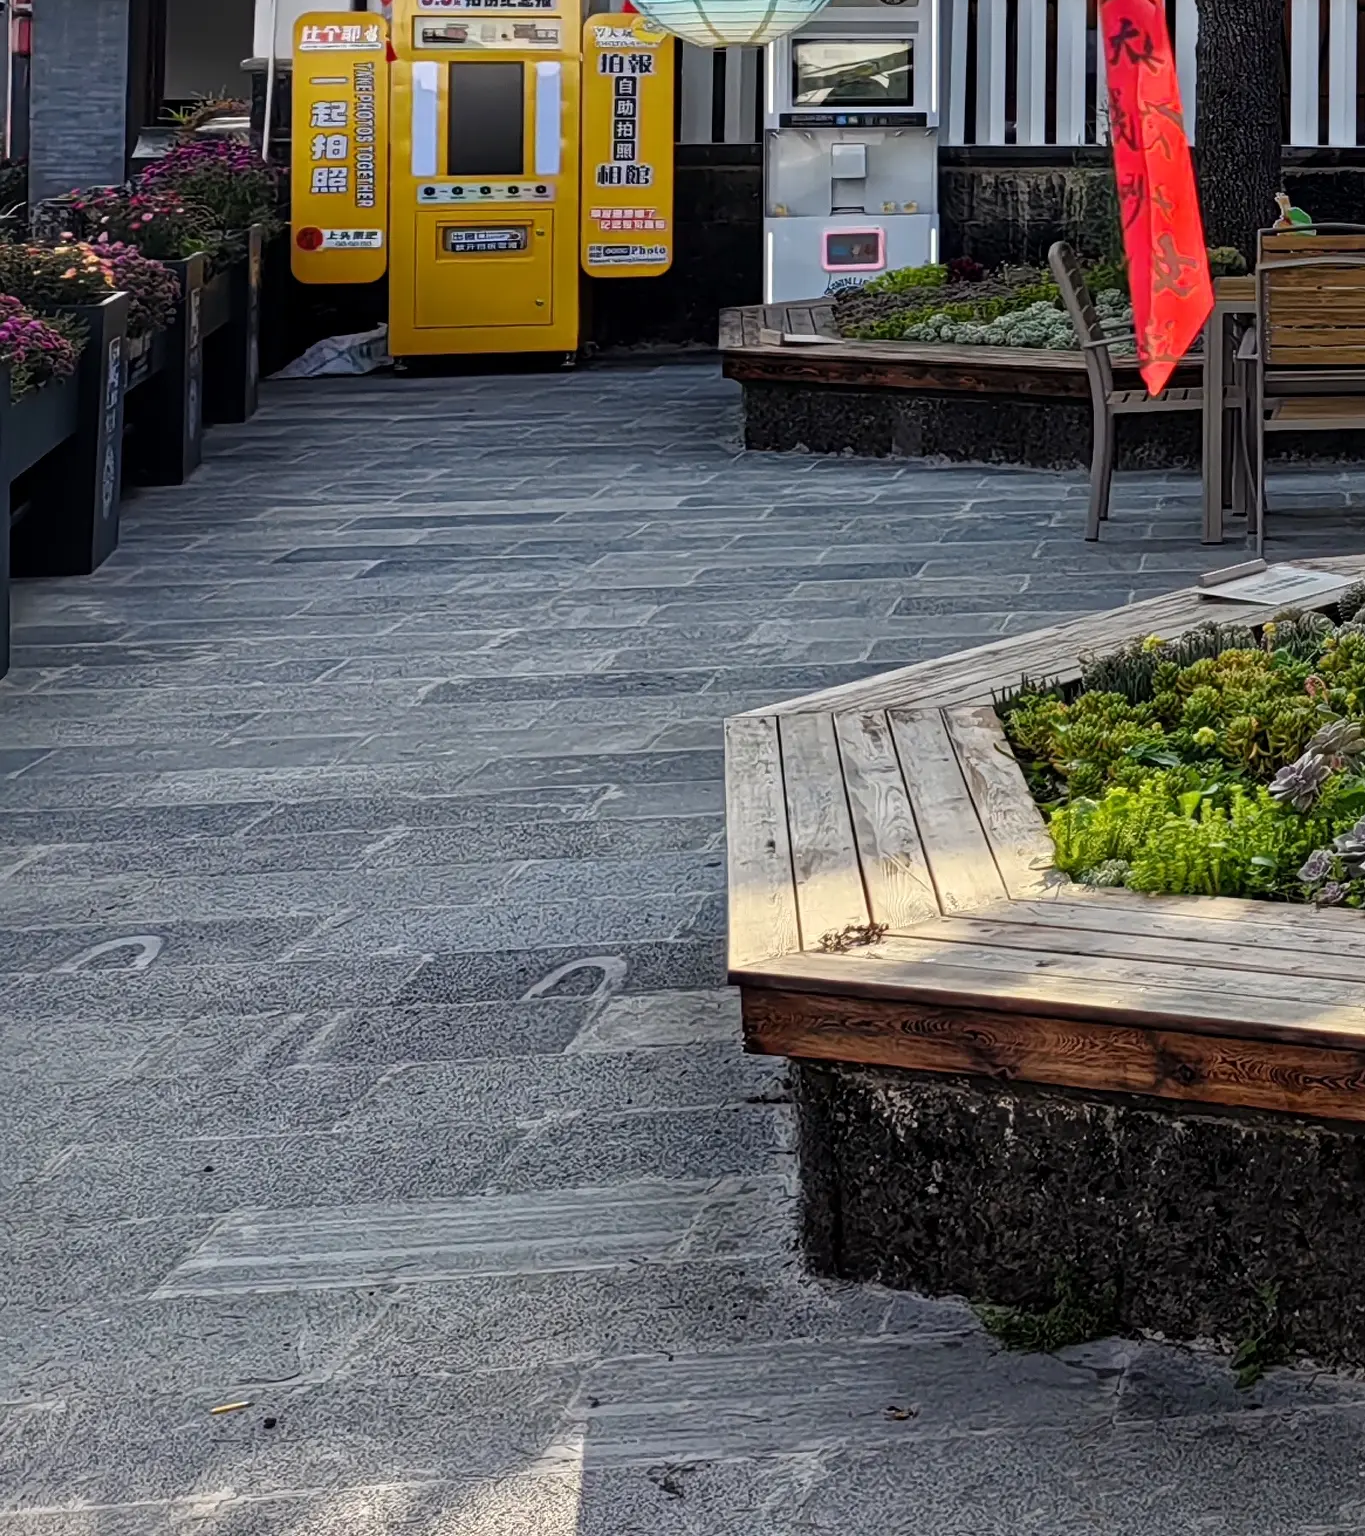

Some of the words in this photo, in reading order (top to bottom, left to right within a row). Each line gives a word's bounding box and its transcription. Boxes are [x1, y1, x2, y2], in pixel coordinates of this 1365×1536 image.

[354, 62, 375, 92] TAKE
[310, 76, 349, 194] 一起拍照
[354, 94, 375, 143] PHOTOS
[616, 77, 637, 161] 自助拍照
[355, 146, 375, 208] TOGETHER
[631, 245, 666, 255] Photo
